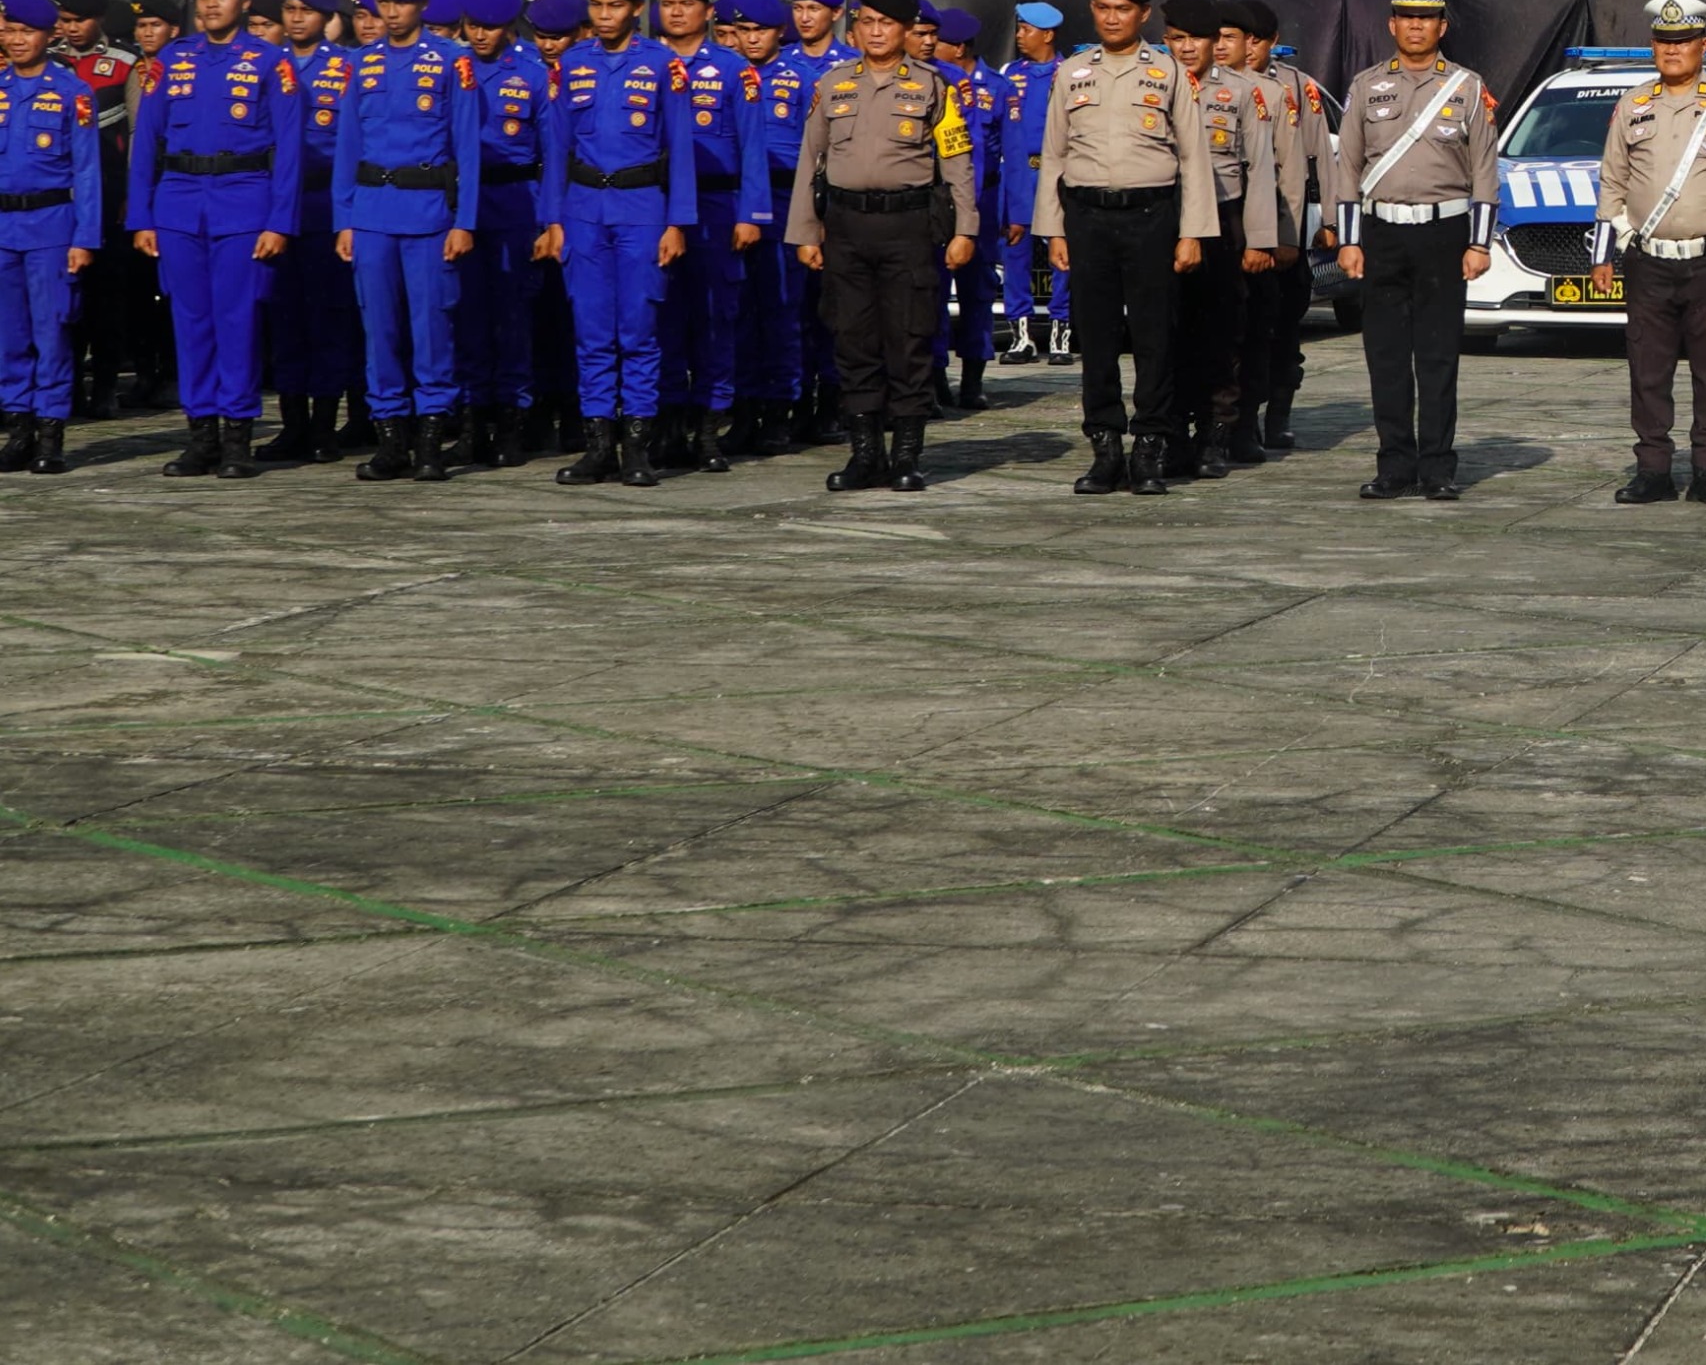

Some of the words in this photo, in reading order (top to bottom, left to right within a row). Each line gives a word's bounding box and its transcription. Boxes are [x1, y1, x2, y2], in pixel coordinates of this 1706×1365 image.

[412, 63, 443, 75] POLRI
[226, 72, 259, 84] POLRI
[770, 78, 800, 89] POLRI
[624, 79, 657, 92] POLRI
[691, 80, 723, 91] POLRI
[1138, 79, 1168, 92] POLRI
[499, 87, 531, 100] POLRI
[831, 92, 859, 102] MARIO
[894, 92, 926, 102] POLRI
[1368, 93, 1399, 105] DEDY
[33, 101, 63, 113] POLRI
[1206, 103, 1238, 114] POLRI
